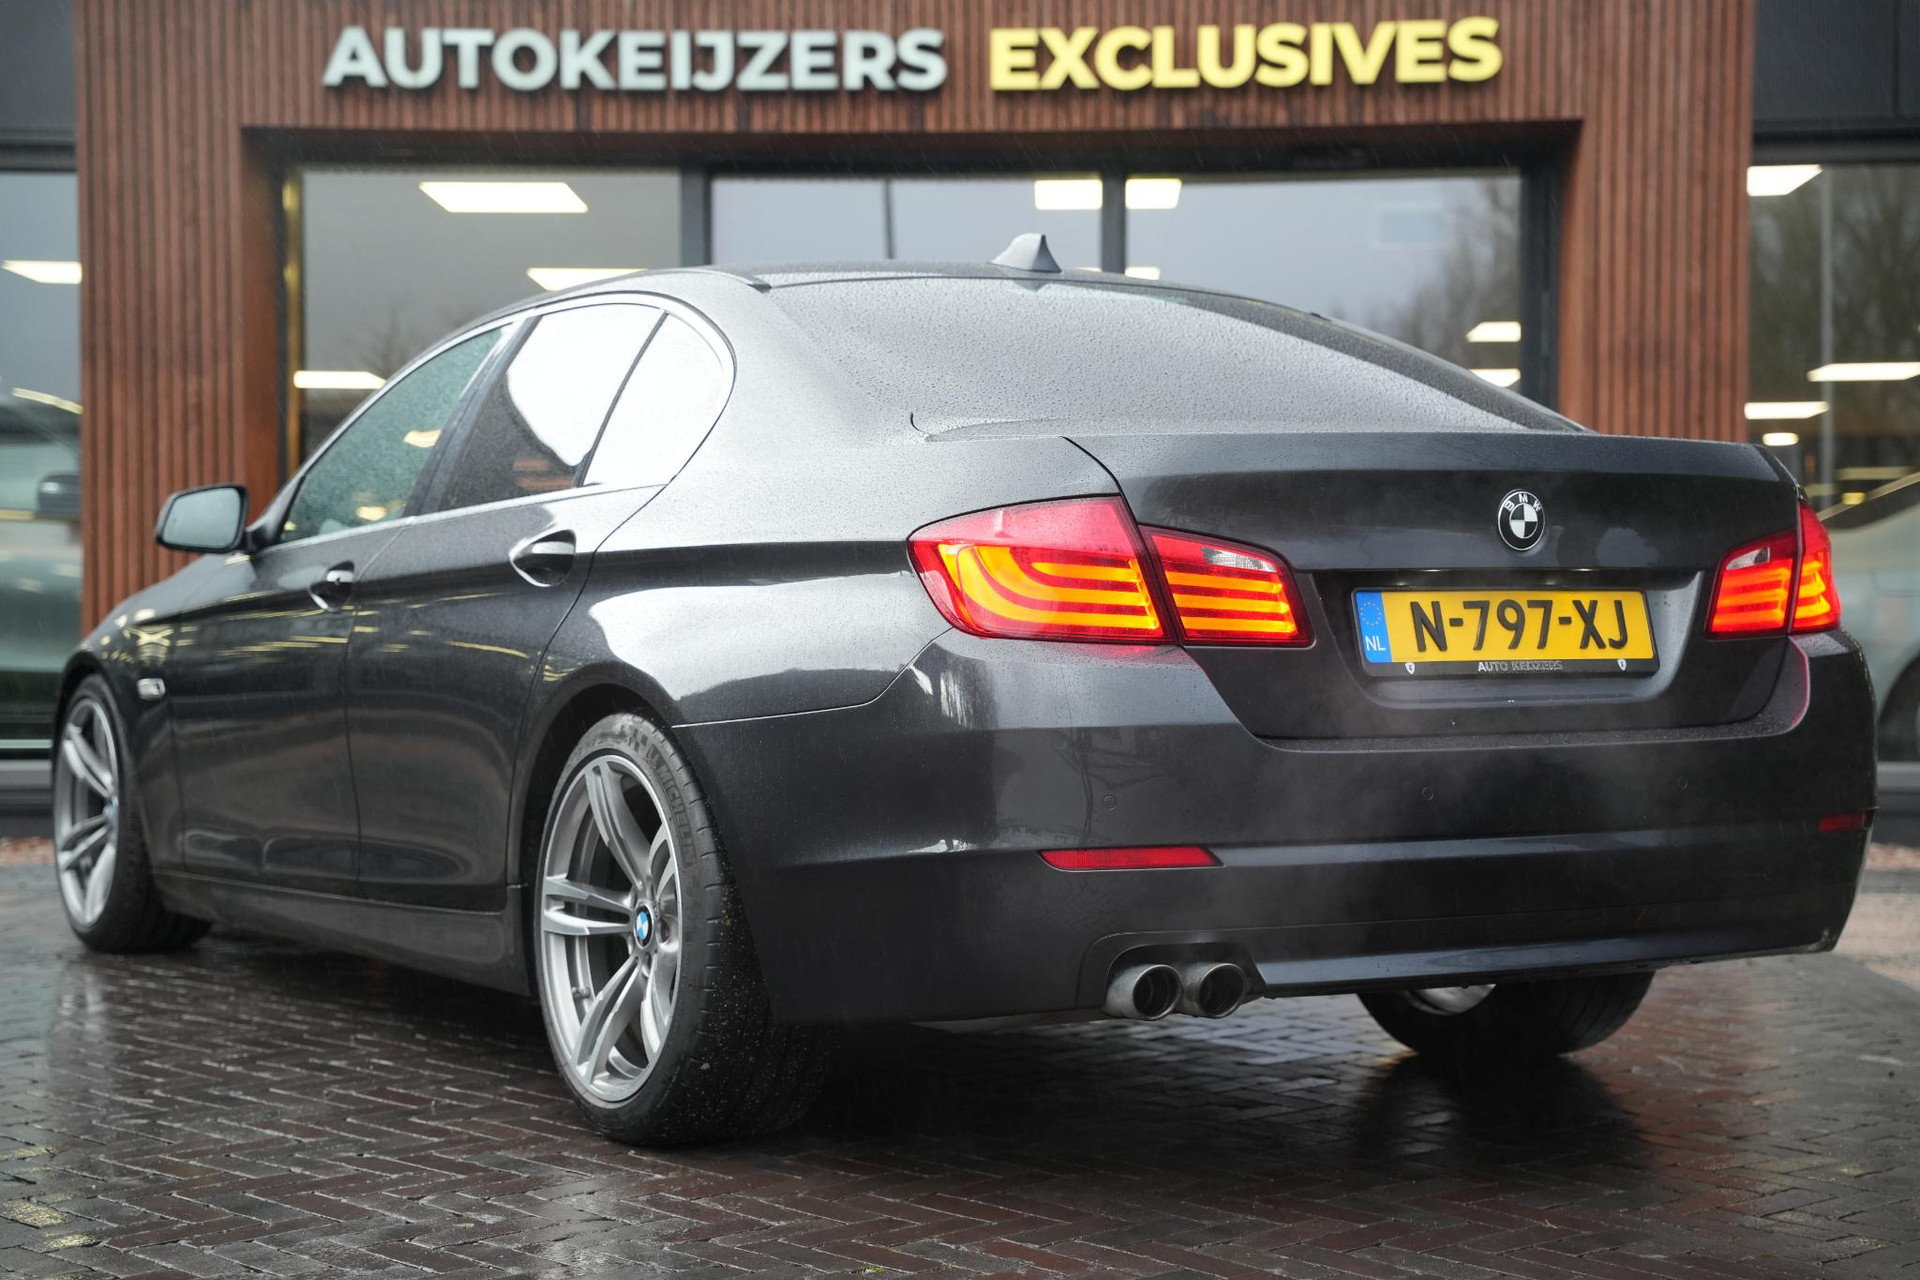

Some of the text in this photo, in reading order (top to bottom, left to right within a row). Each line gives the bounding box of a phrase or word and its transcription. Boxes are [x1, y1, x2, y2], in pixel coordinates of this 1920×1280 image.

[322, 16, 1504, 92] AUTOKEIJZERS EXCLUSIVES
[1504, 493, 1543, 512] BMW
[1365, 635, 1387, 651] NL
[1410, 600, 1628, 652] N-797-XJ
[1478, 661, 1508, 672] AUTO
[656, 763, 697, 868] MICHELIN
